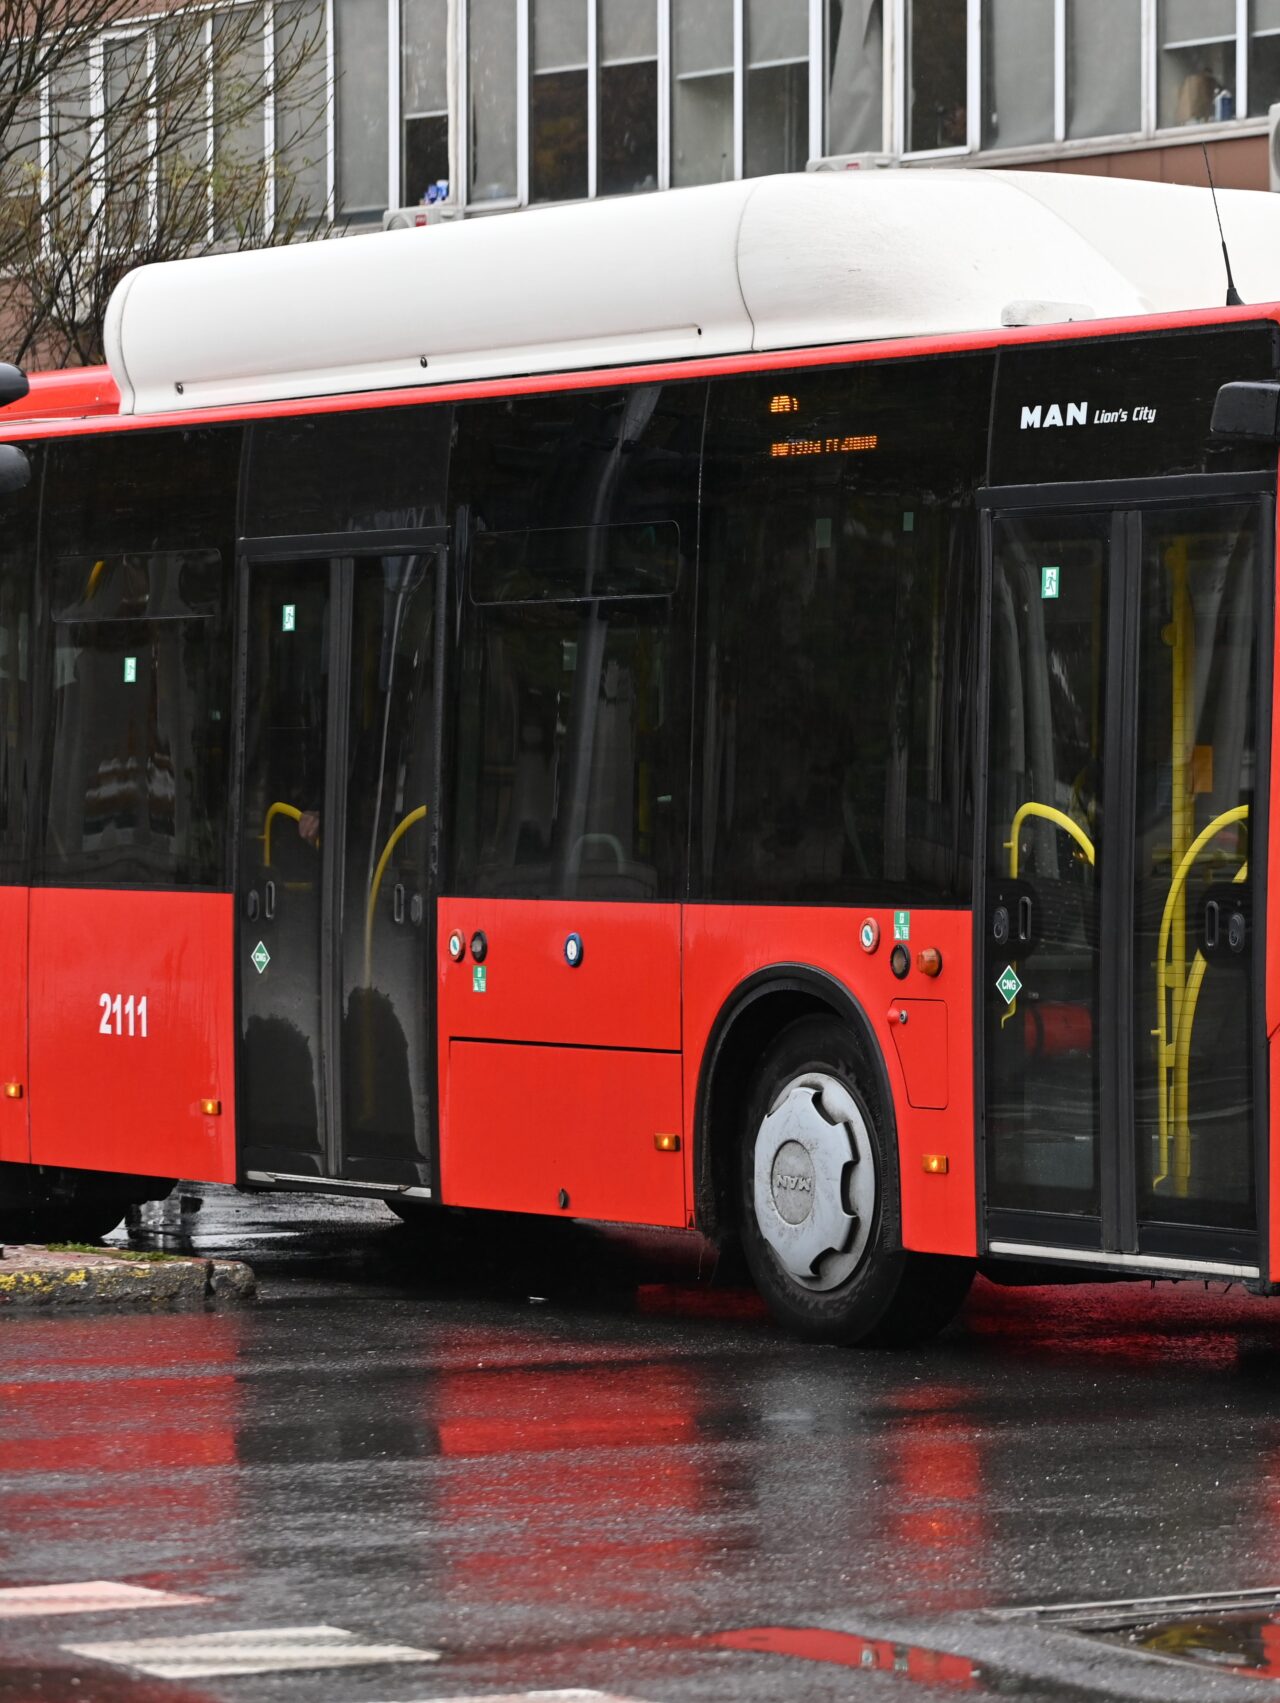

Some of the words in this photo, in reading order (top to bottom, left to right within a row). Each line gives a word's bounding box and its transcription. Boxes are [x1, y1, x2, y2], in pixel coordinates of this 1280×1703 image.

[1020, 402, 1088, 429] MAN
[1093, 408, 1128, 424] Lion's
[1132, 406, 1157, 424] City
[1001, 979, 1017, 991] CNG
[98, 993, 148, 1038] 2111
[777, 1174, 811, 1192] MAN
